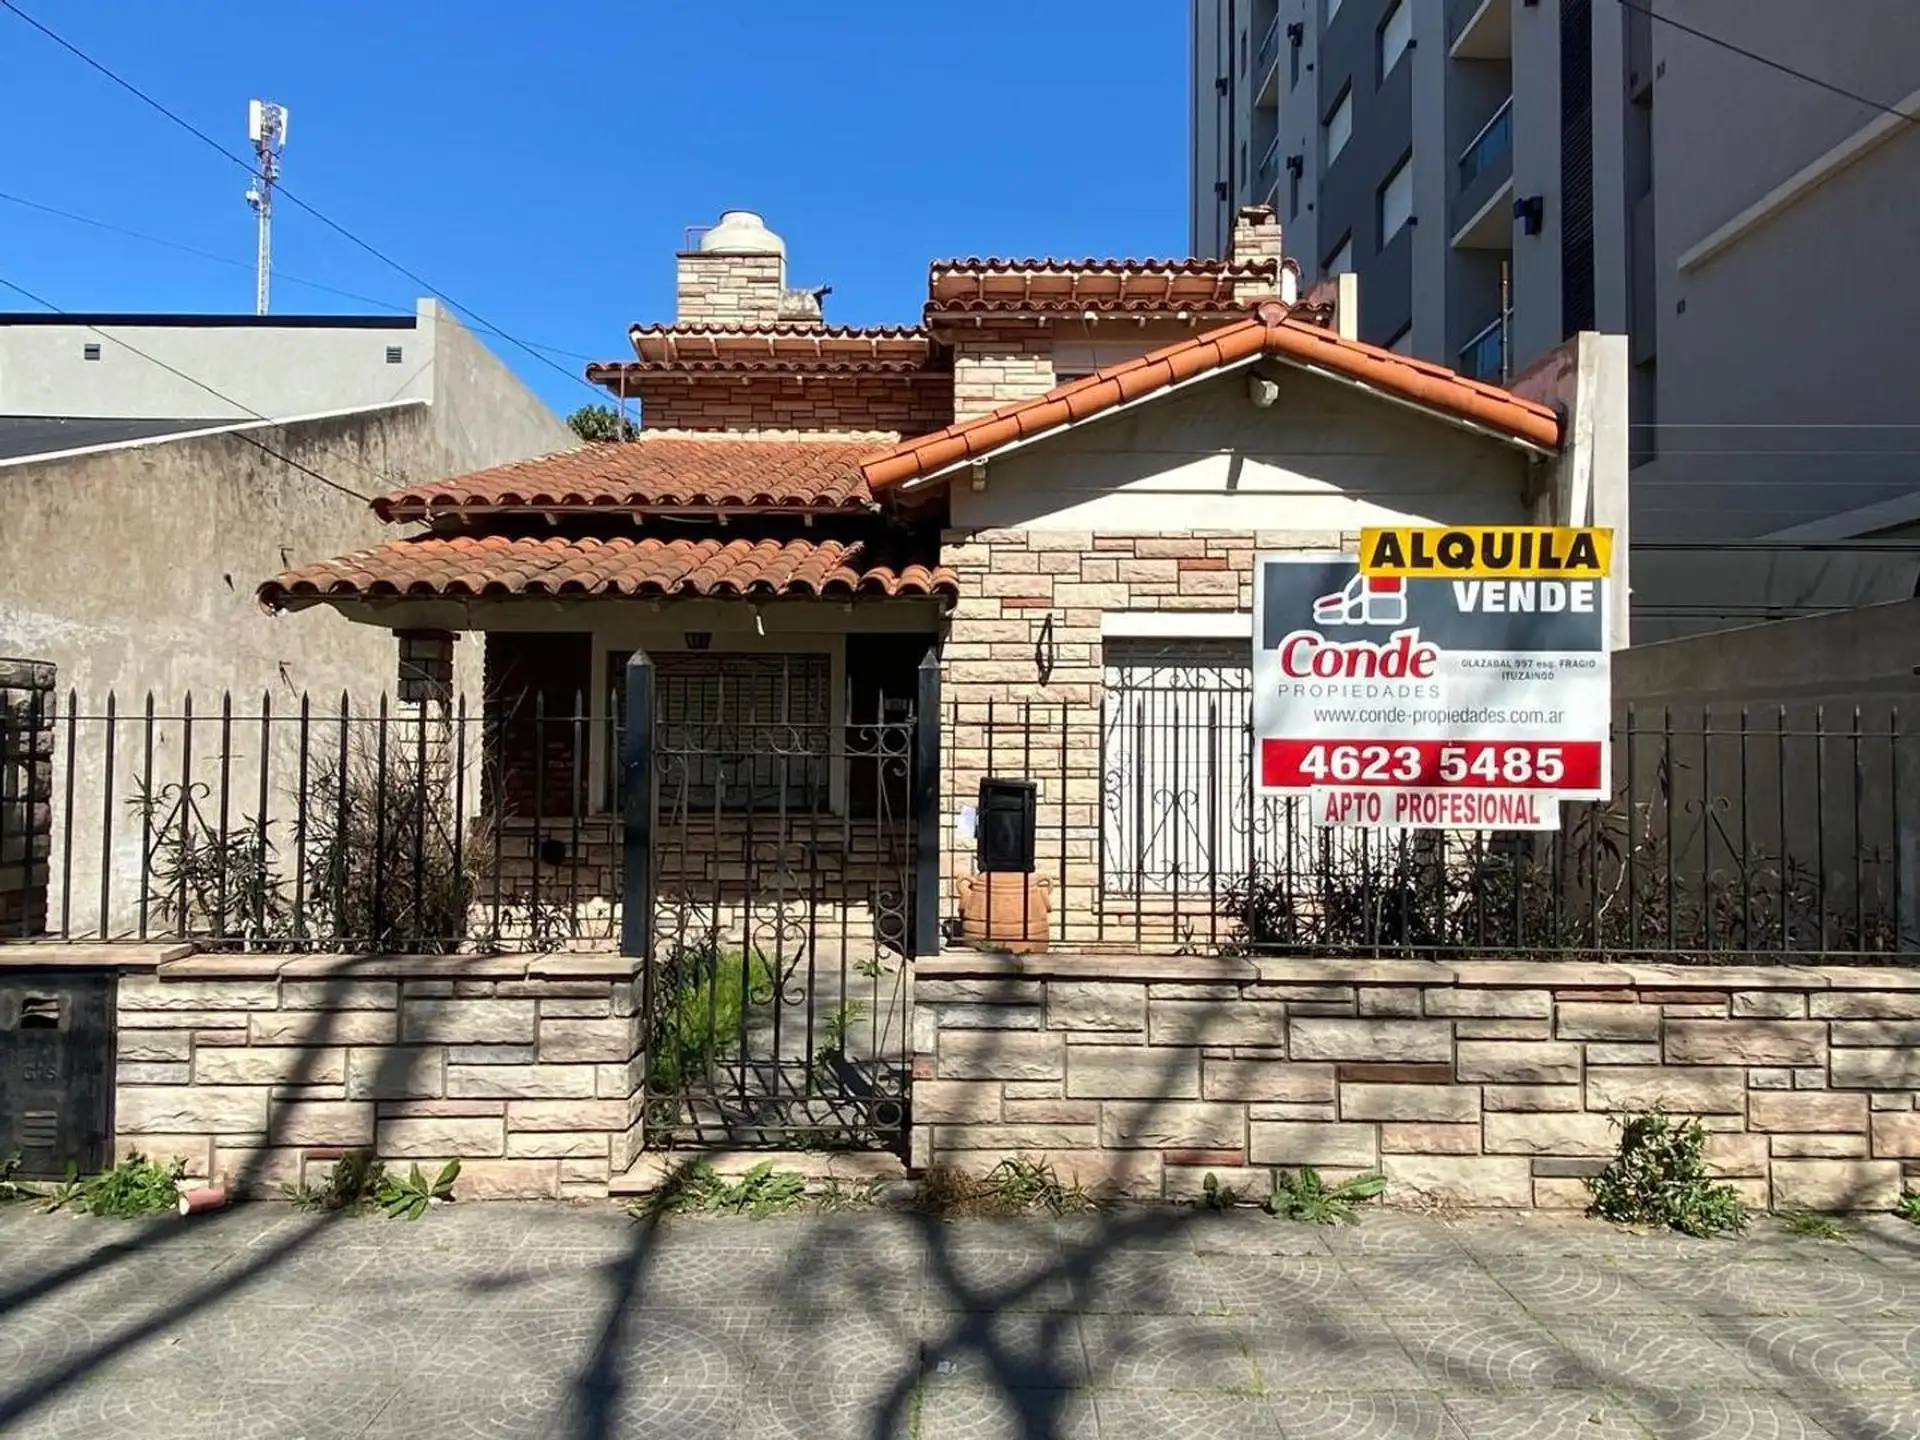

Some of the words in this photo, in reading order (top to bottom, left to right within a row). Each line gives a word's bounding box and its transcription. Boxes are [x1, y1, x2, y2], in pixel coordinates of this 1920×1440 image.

[1369, 531, 1601, 569] ALQUILA
[1452, 580, 1594, 613] VENDE
[1281, 635, 1437, 678] Conde
[1278, 684, 1440, 698] PROPIEDADES
[1314, 705, 1565, 725] www.conde-propiedades.com.ar
[1300, 746, 1422, 780] 4623
[1439, 747, 1565, 783] 5485
[1325, 792, 1381, 823] APTO
[1396, 793, 1540, 824] PROFESIONAL
